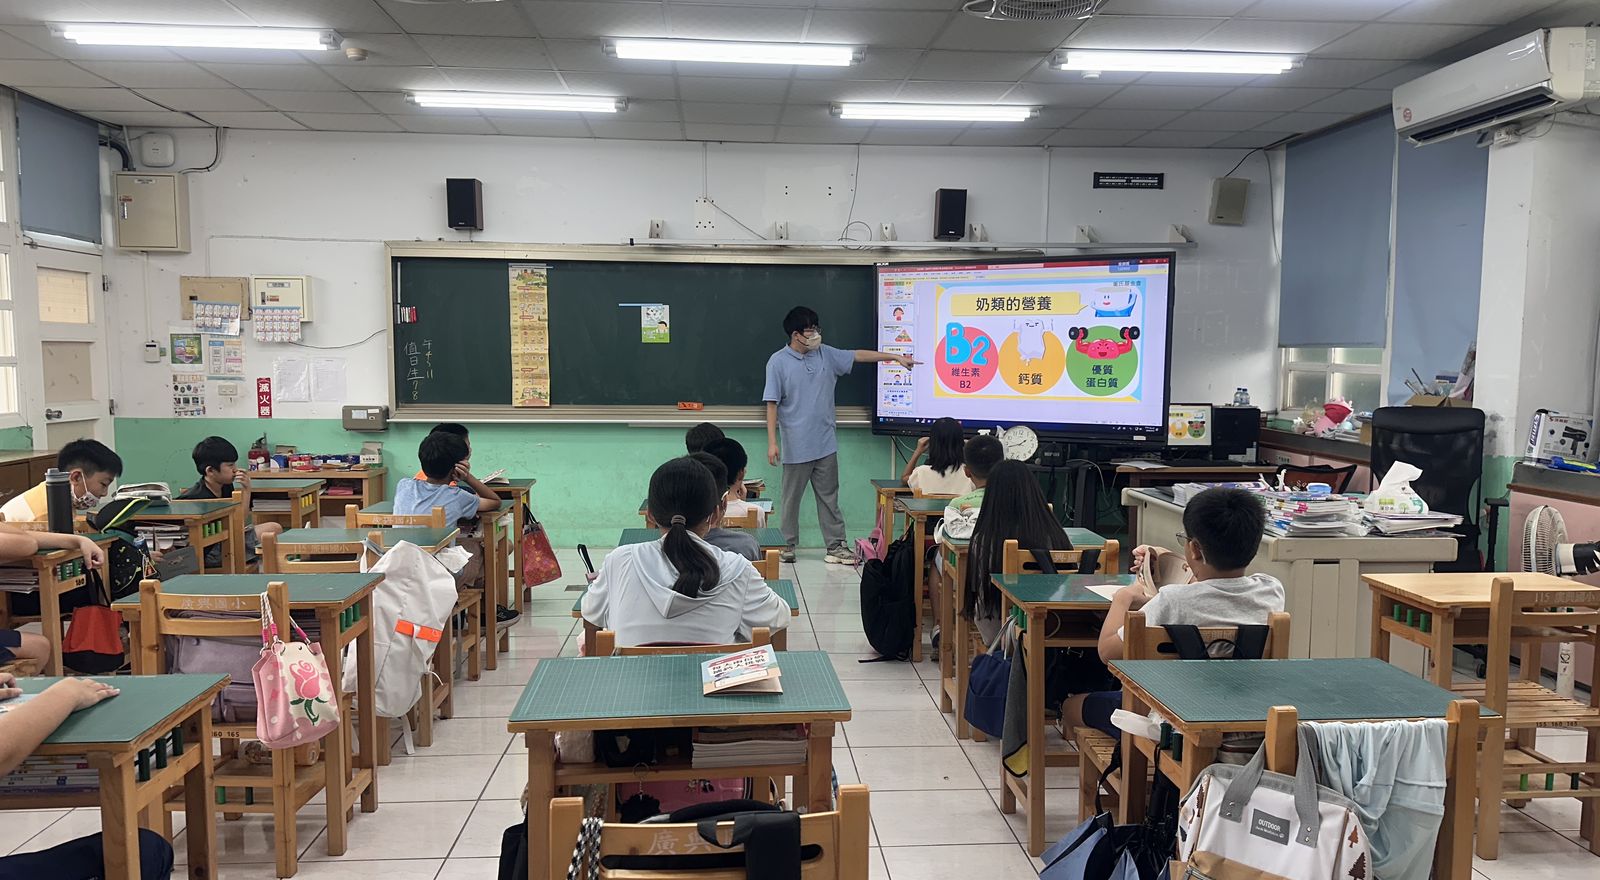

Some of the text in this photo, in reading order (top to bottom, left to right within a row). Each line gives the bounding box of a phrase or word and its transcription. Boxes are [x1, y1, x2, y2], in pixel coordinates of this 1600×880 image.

[976, 296, 1052, 311] 奶類的營養
[945, 322, 991, 365] B2
[951, 367, 981, 377] 維生素
[1091, 364, 1114, 375] 優質
[959, 380, 972, 389] B2
[1018, 373, 1043, 385] 鈣質
[1085, 377, 1119, 388] 蛋白質
[258, 382, 270, 416] 滅火器
[1258, 819, 1281, 832] OUTDOOR
[647, 830, 733, 855] 廣興
